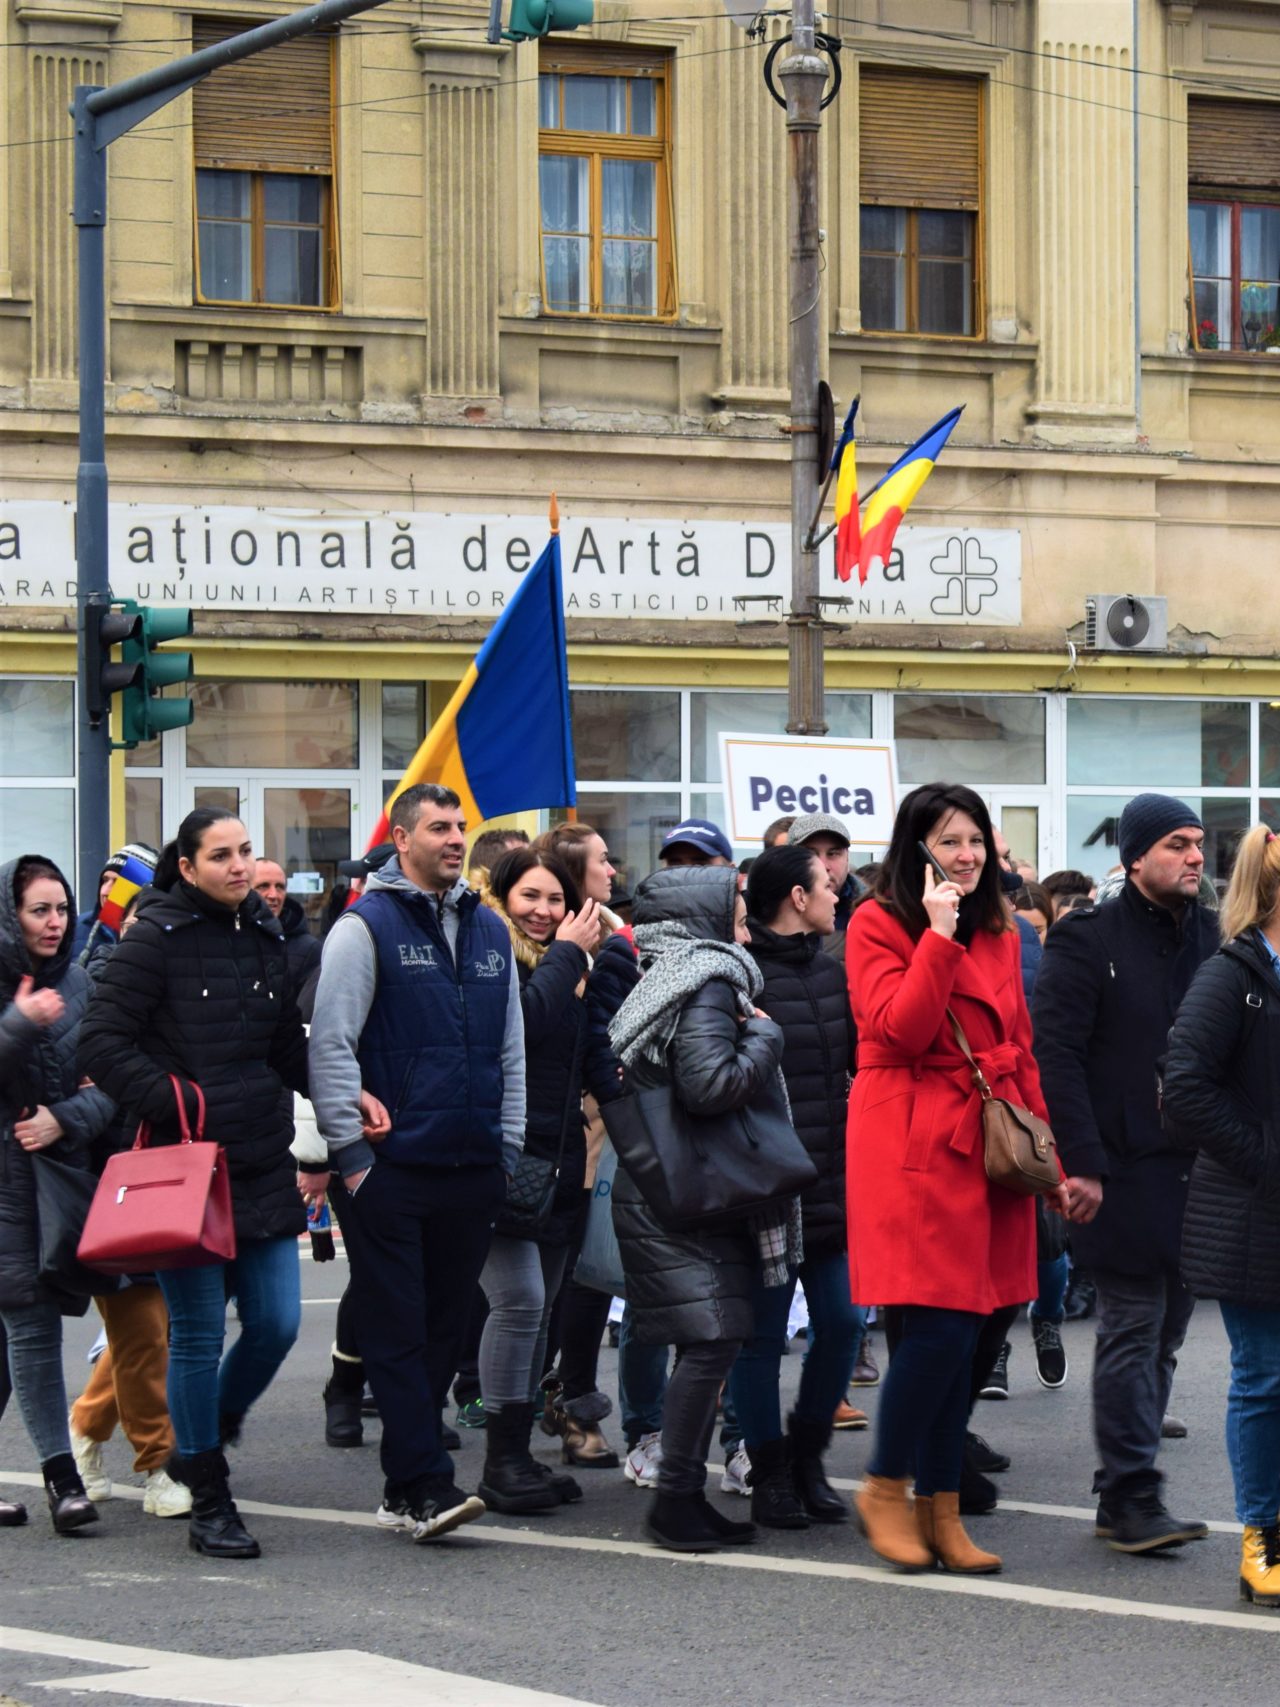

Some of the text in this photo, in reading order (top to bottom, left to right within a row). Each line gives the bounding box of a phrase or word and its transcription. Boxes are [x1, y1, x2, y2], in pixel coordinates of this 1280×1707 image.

[73, 511, 416, 580] ațională
[462, 524, 531, 573] de
[572, 526, 700, 577] Artă
[137, 582, 277, 602] UNIUNII
[566, 592, 675, 610] ASTICI
[696, 595, 746, 612] DIN
[748, 774, 875, 815] Pecica
